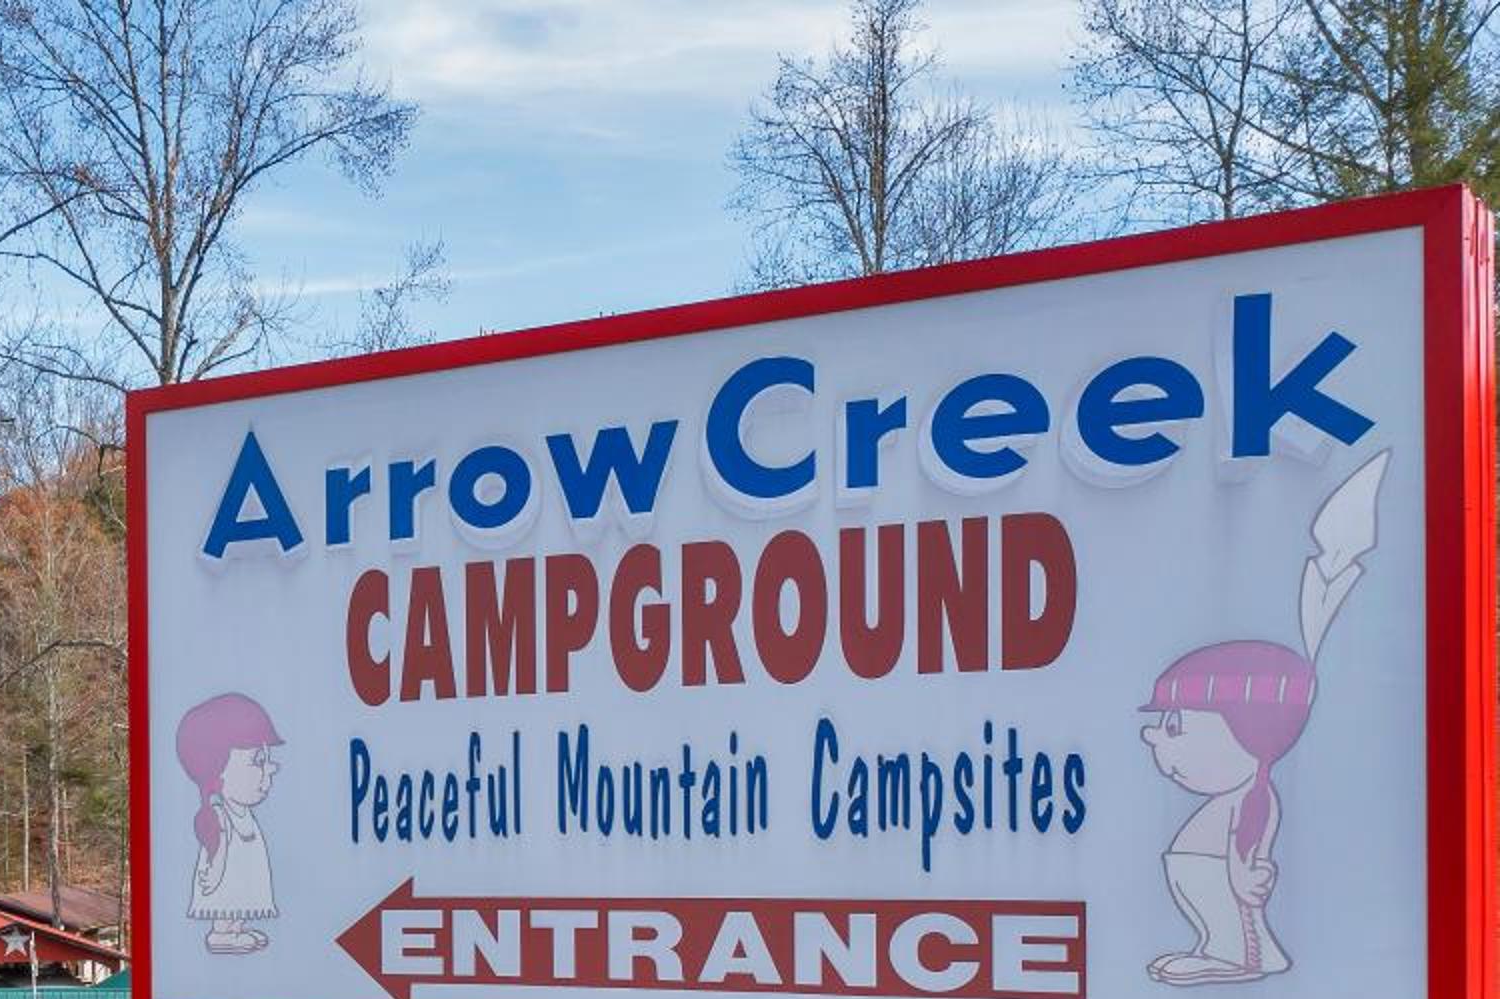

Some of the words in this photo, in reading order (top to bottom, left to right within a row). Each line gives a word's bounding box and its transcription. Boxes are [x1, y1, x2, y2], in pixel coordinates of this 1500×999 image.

[345, 512, 1079, 708] CAMPGROUND
[349, 734, 523, 844] Peaceful
[557, 722, 769, 838] Mountain
[810, 717, 1088, 874] Campsites
[380, 909, 1080, 995] ENTRANCE
